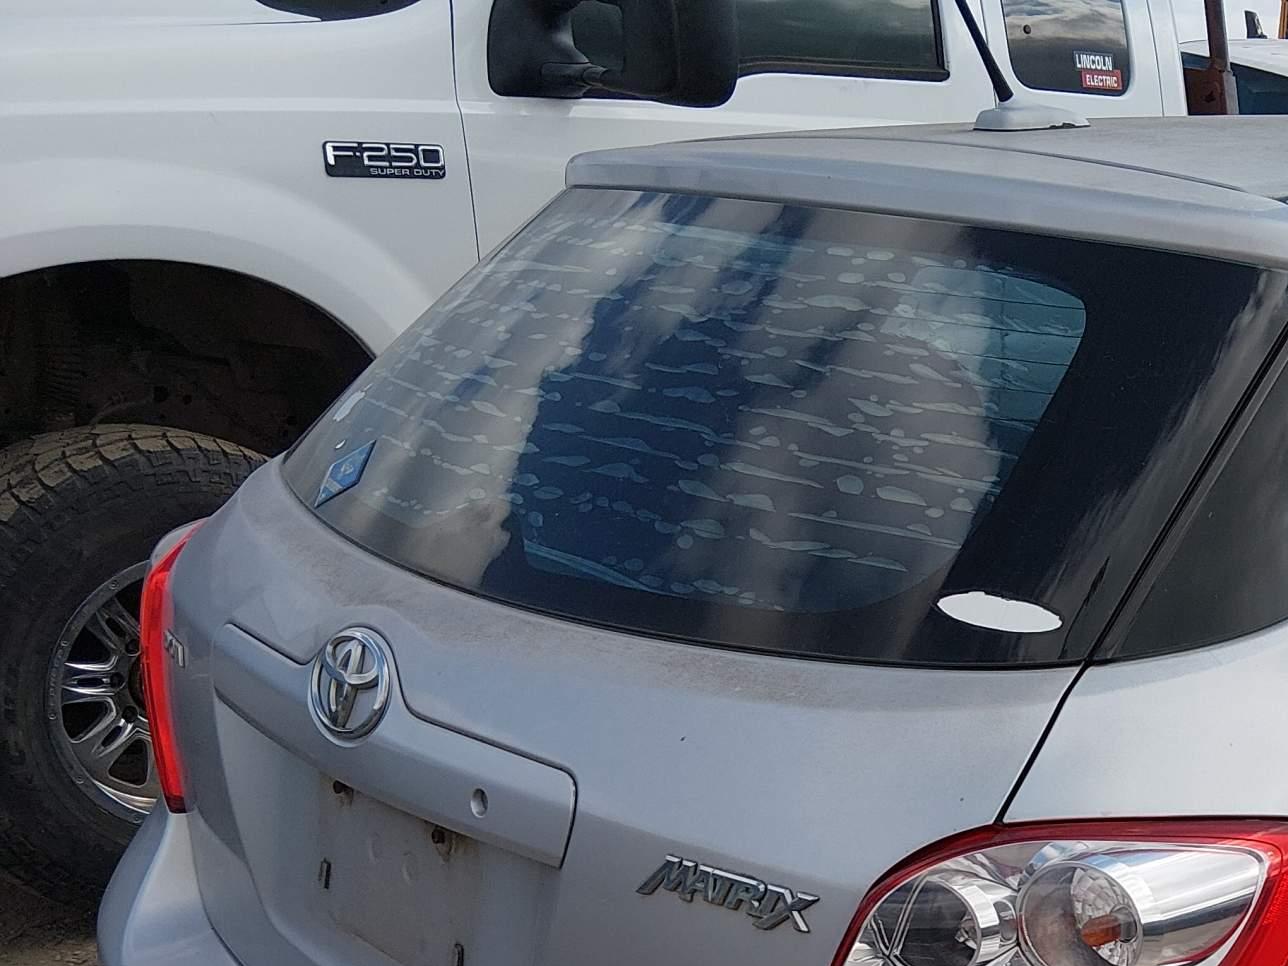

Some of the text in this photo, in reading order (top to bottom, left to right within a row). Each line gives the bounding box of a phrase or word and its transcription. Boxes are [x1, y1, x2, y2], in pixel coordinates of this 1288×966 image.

[1075, 53, 1113, 70] LINCOLN
[1085, 74, 1118, 87] ELECTRIC
[370, 167, 445, 177] SUPER DUTY
[636, 853, 821, 933] MATRIX
